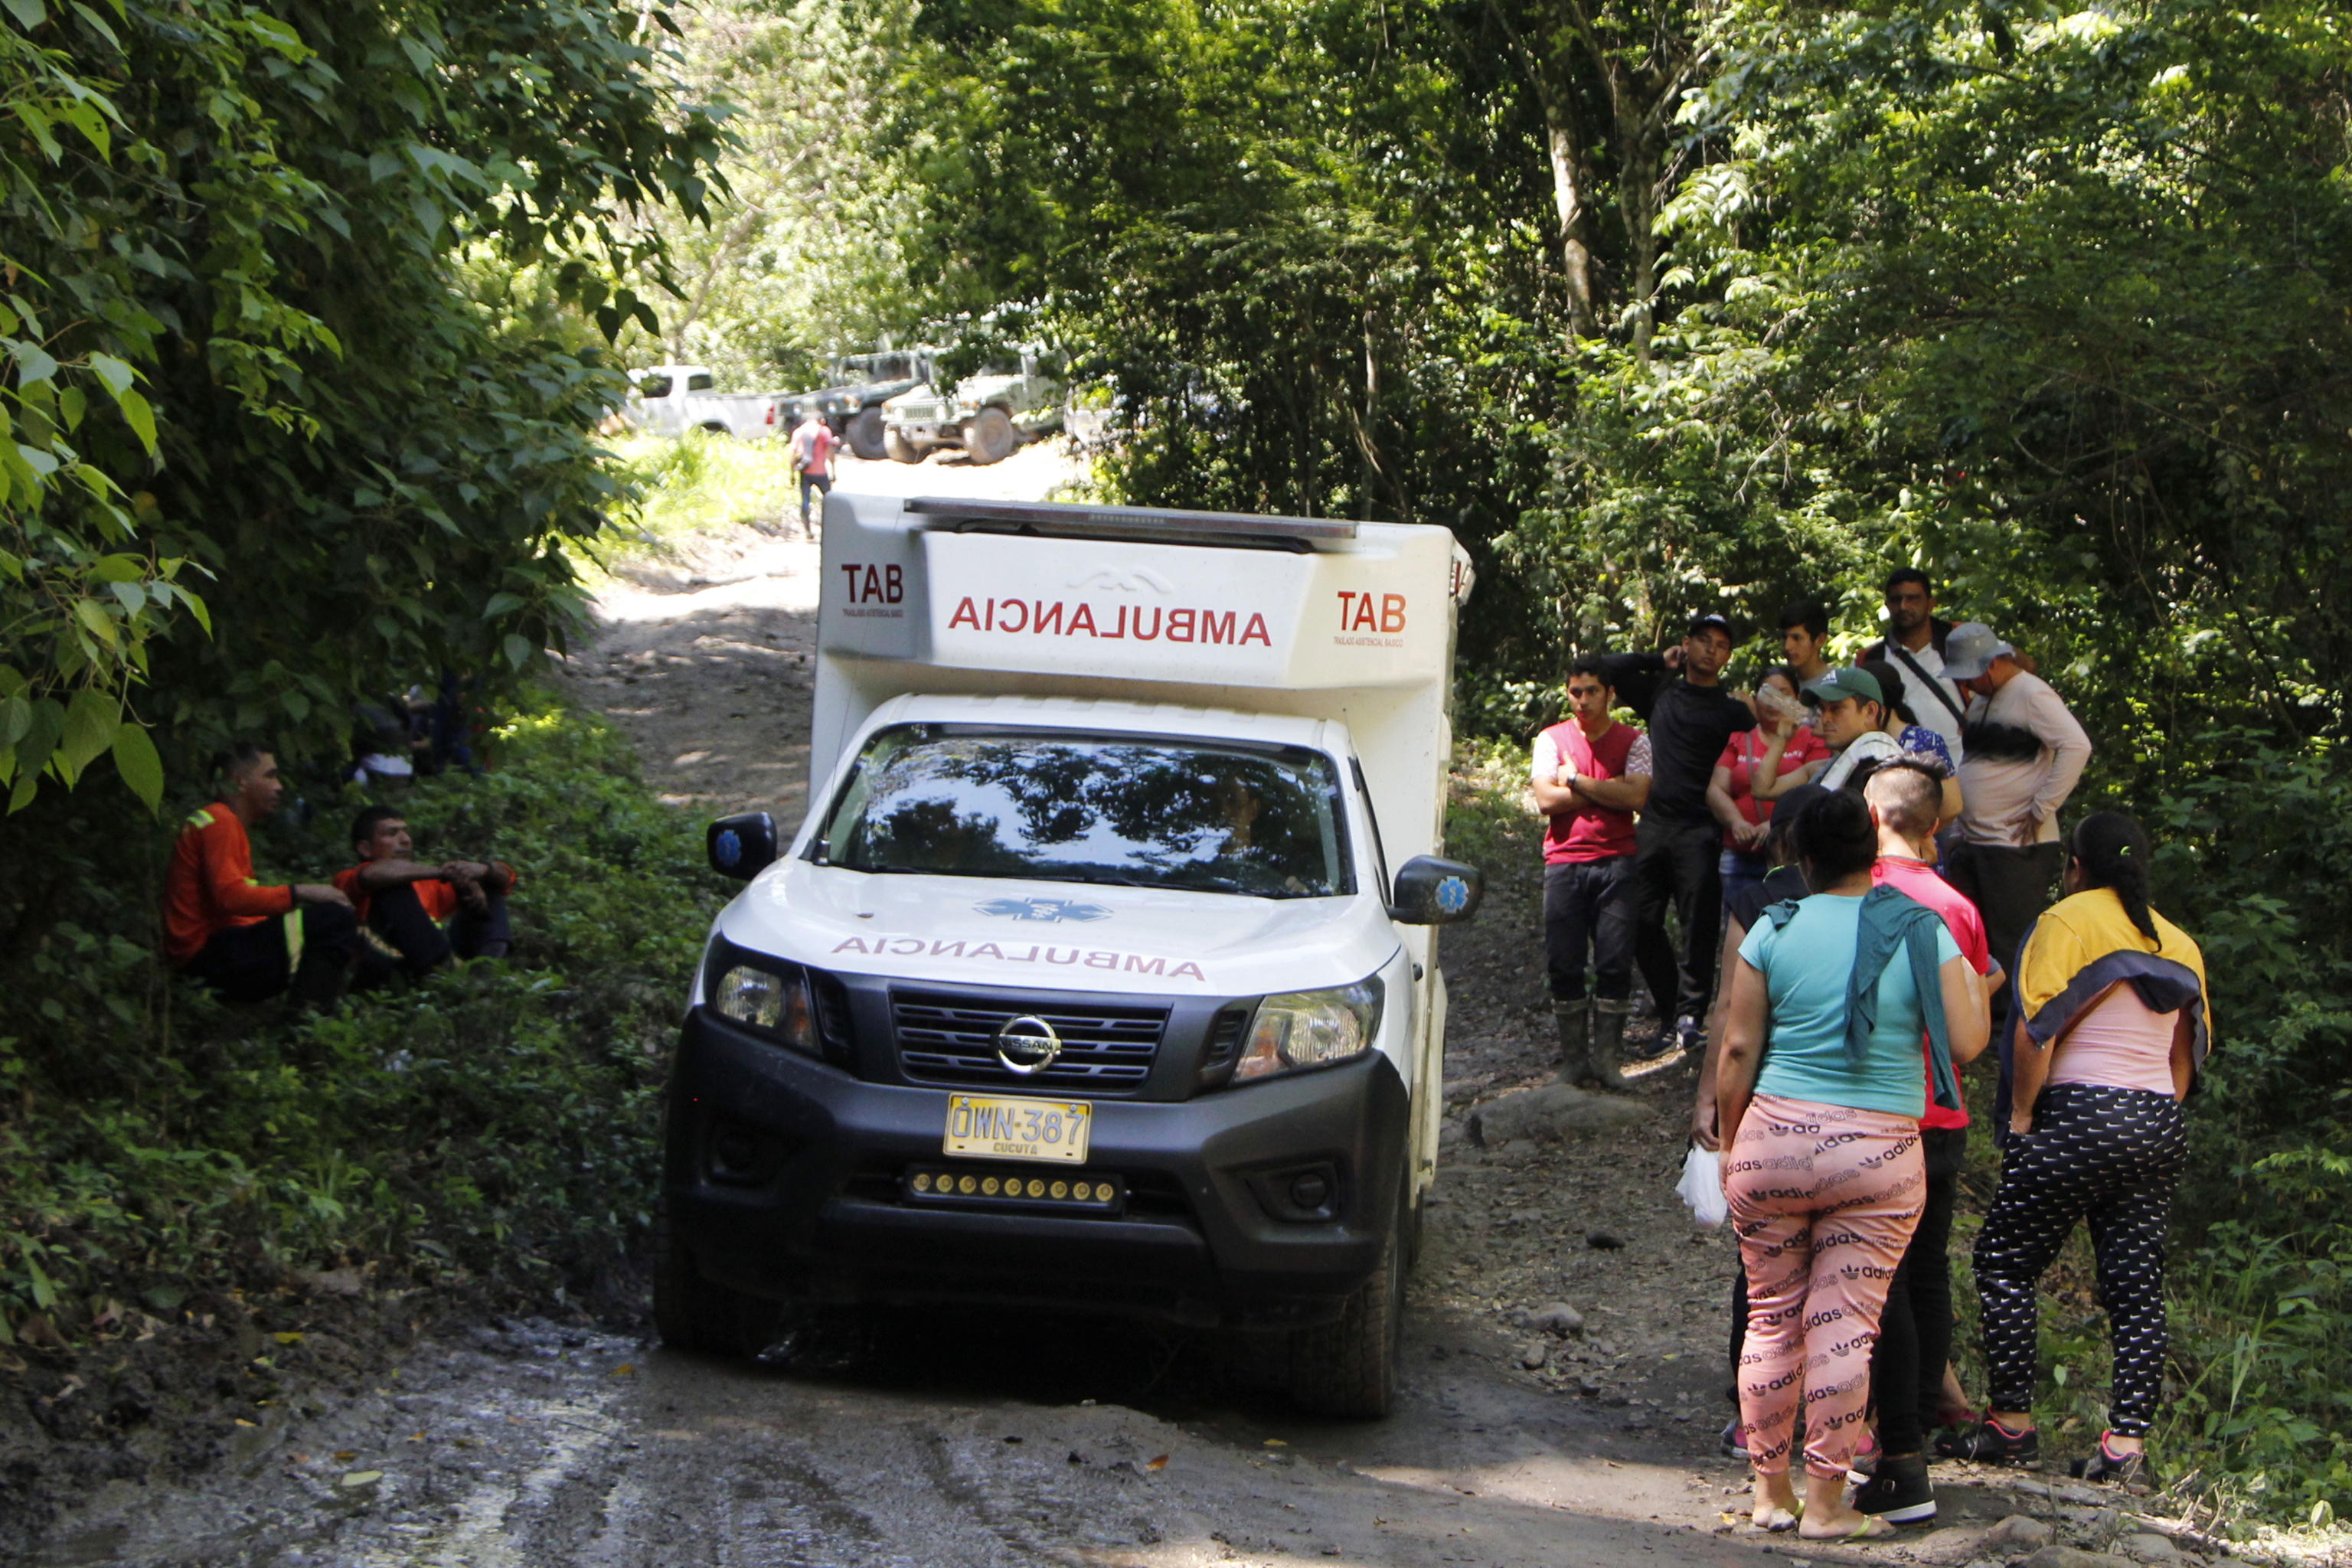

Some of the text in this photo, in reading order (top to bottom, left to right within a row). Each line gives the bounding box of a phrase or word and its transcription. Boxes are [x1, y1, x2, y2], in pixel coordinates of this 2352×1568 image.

[841, 564, 903, 603] TAB
[1338, 591, 1406, 632] TAB
[998, 1038, 1054, 1050] NISSAN
[993, 1142, 1038, 1155] CUCUTA
[1762, 1155, 1814, 1171] adid
[1769, 1363, 1803, 1390] adid
[1808, 1389, 1838, 1403] das
